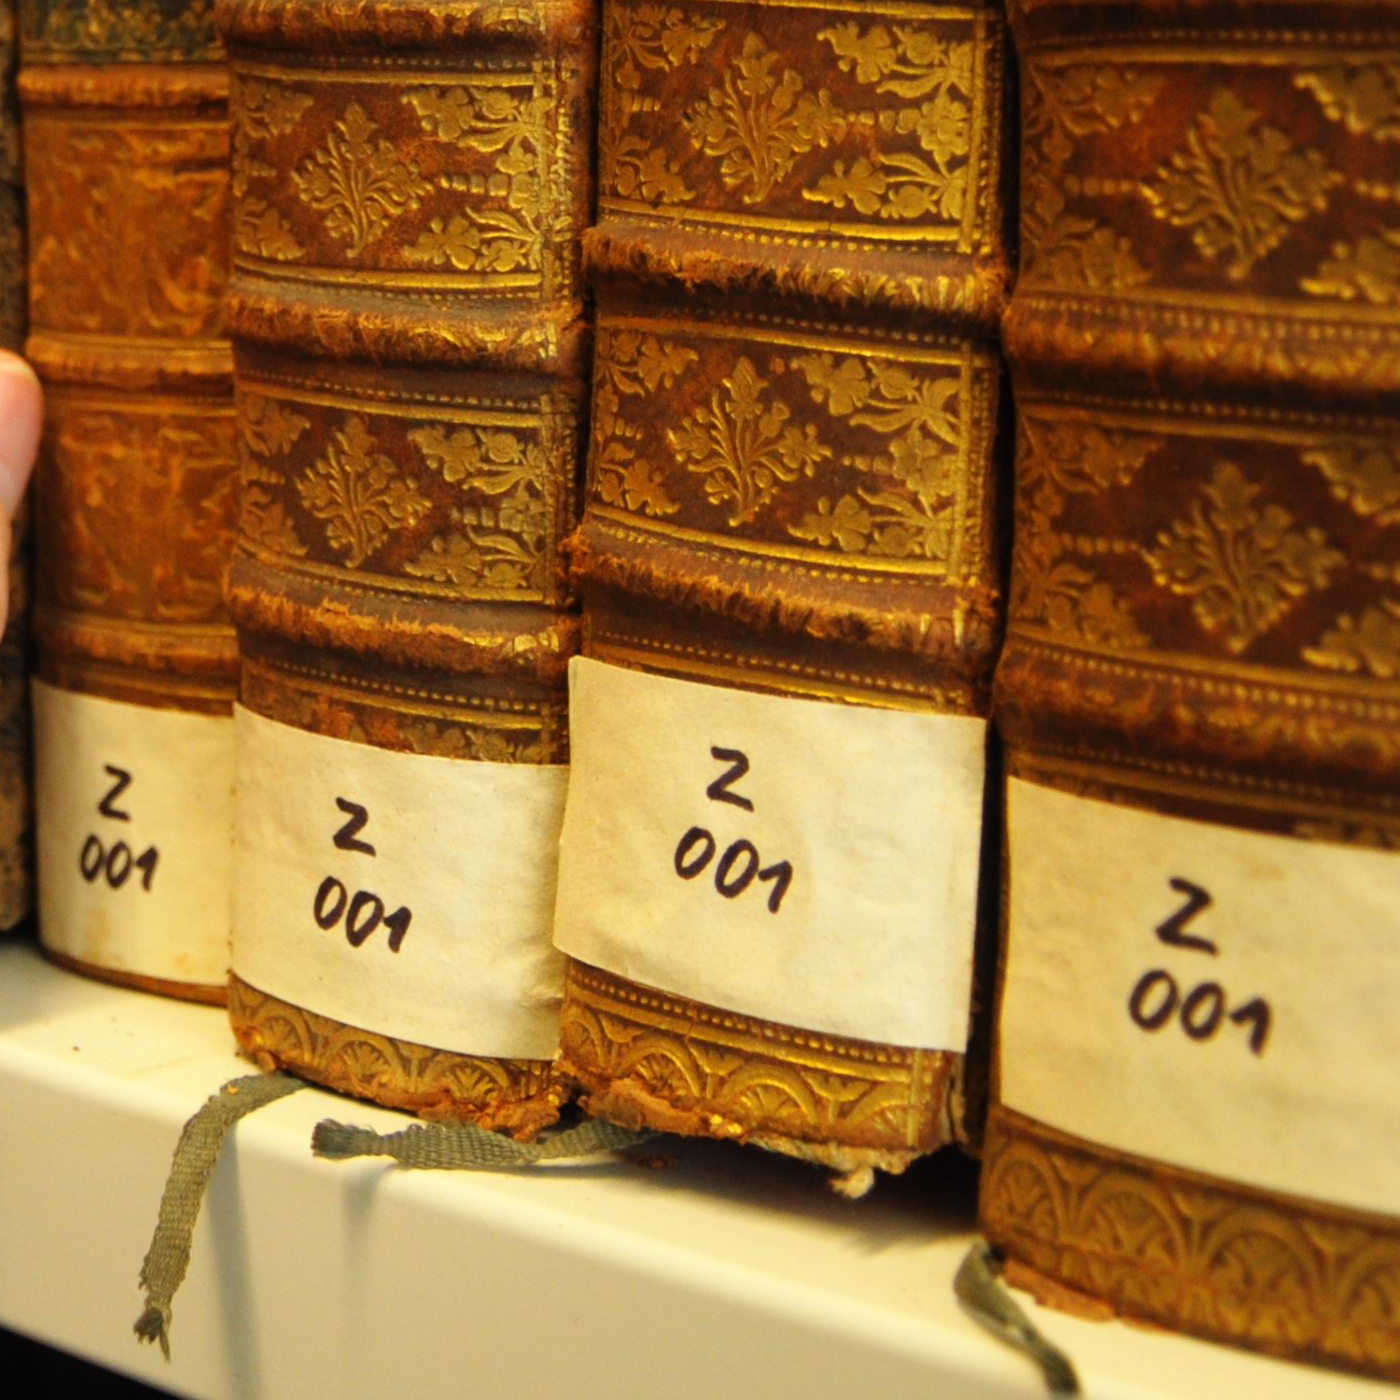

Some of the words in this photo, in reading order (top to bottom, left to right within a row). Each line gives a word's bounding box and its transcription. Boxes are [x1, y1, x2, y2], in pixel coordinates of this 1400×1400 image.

[99, 763, 133, 822] Z
[706, 746, 754, 813] Z
[79, 833, 160, 892] 001
[333, 796, 377, 858] Z
[674, 826, 793, 914] 001
[313, 875, 413, 954] 001
[1155, 876, 1220, 956] Z
[1127, 968, 1273, 1057] 001
